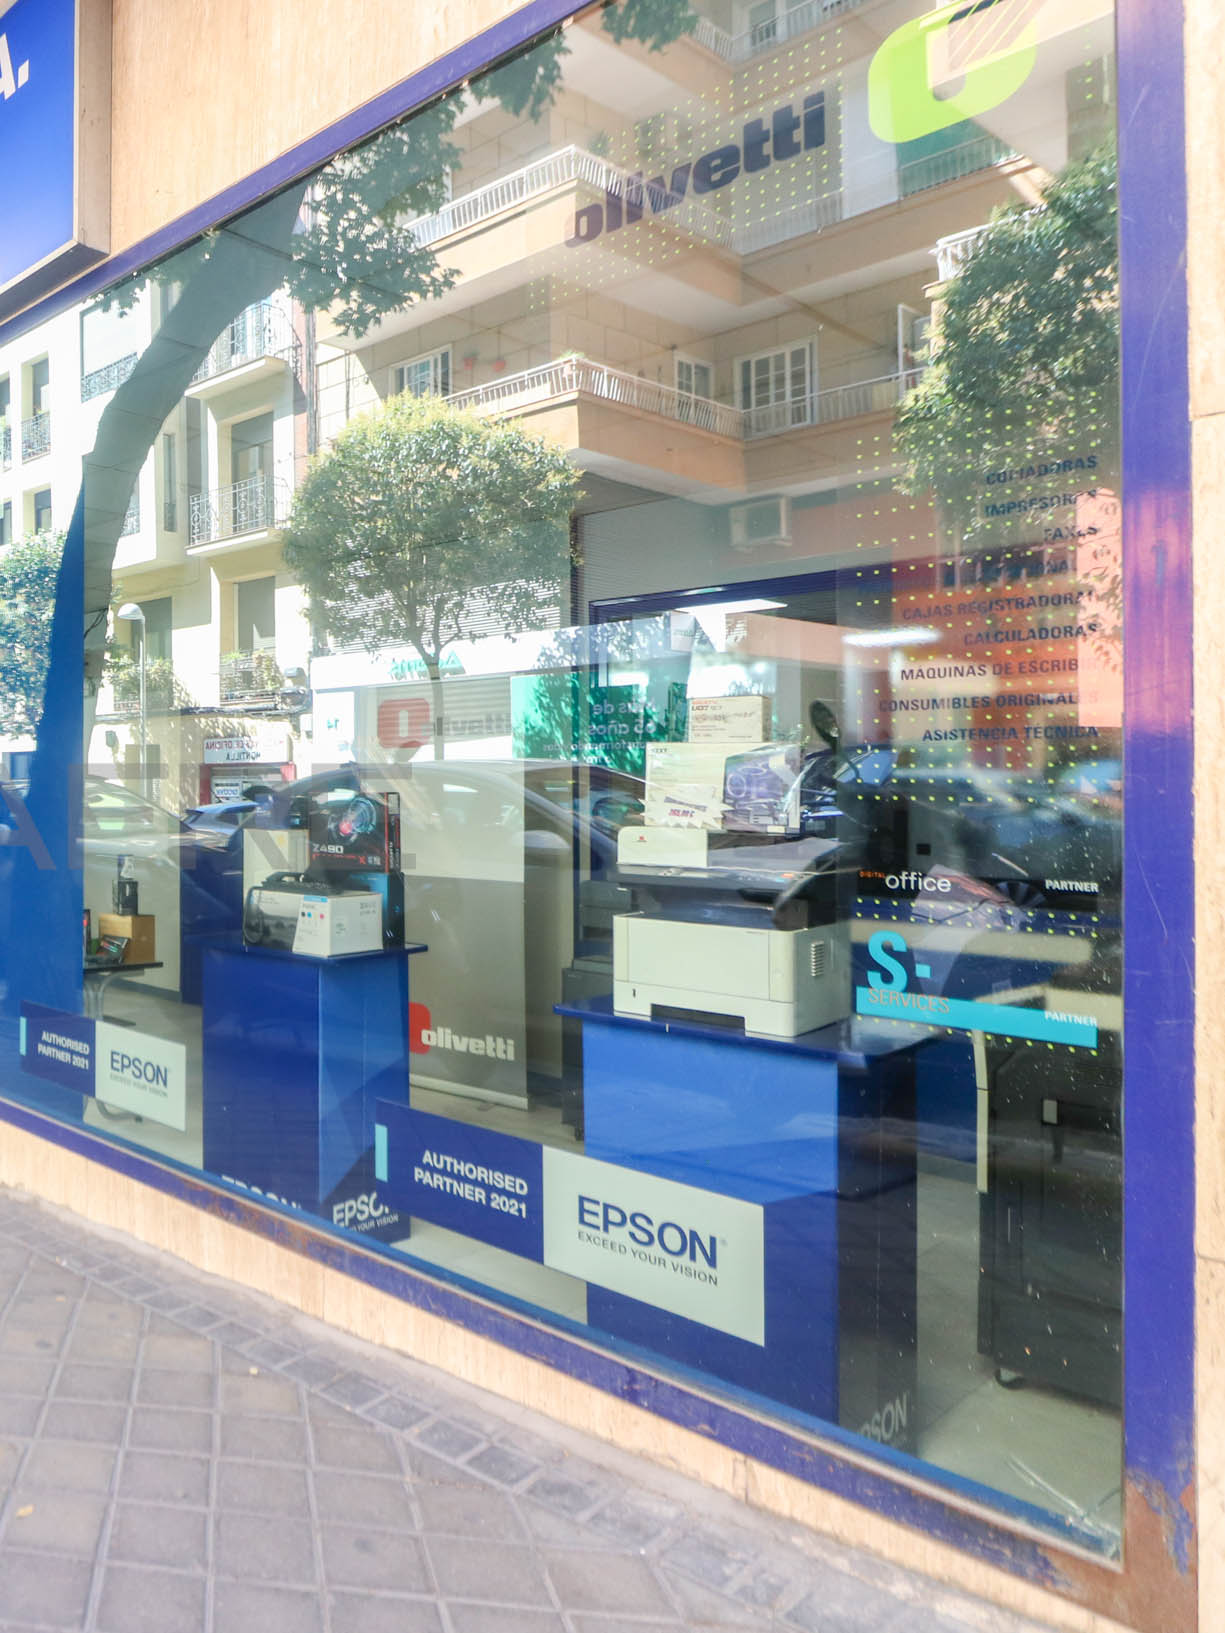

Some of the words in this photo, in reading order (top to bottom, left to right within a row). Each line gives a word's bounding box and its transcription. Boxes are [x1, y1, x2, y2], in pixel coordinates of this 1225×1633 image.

[564, 91, 825, 248] olivetti
[991, 661, 1014, 676] DE
[878, 695, 991, 712] CONSUMIBLES
[922, 725, 1019, 742] ASISTENCIA
[885, 871, 951, 893] office
[1044, 879, 1100, 893] PARTNER
[867, 988, 951, 1015] SERVICES
[1043, 1010, 1098, 1027] PARTNER
[37, 1042, 72, 1064] PARTNER
[41, 1030, 90, 1056] AUTHORISED
[421, 1026, 515, 1061] olivetti
[110, 1050, 168, 1088] EPSON
[422, 1149, 529, 1196] AUTHORISED
[413, 1166, 486, 1205] PARTNER
[490, 1192, 527, 1219] 2021
[578, 1194, 717, 1270] EPSON
[578, 1230, 627, 1254] EXCEED
[631, 1247, 667, 1269] YOUR
[671, 1261, 718, 1287] VISION
